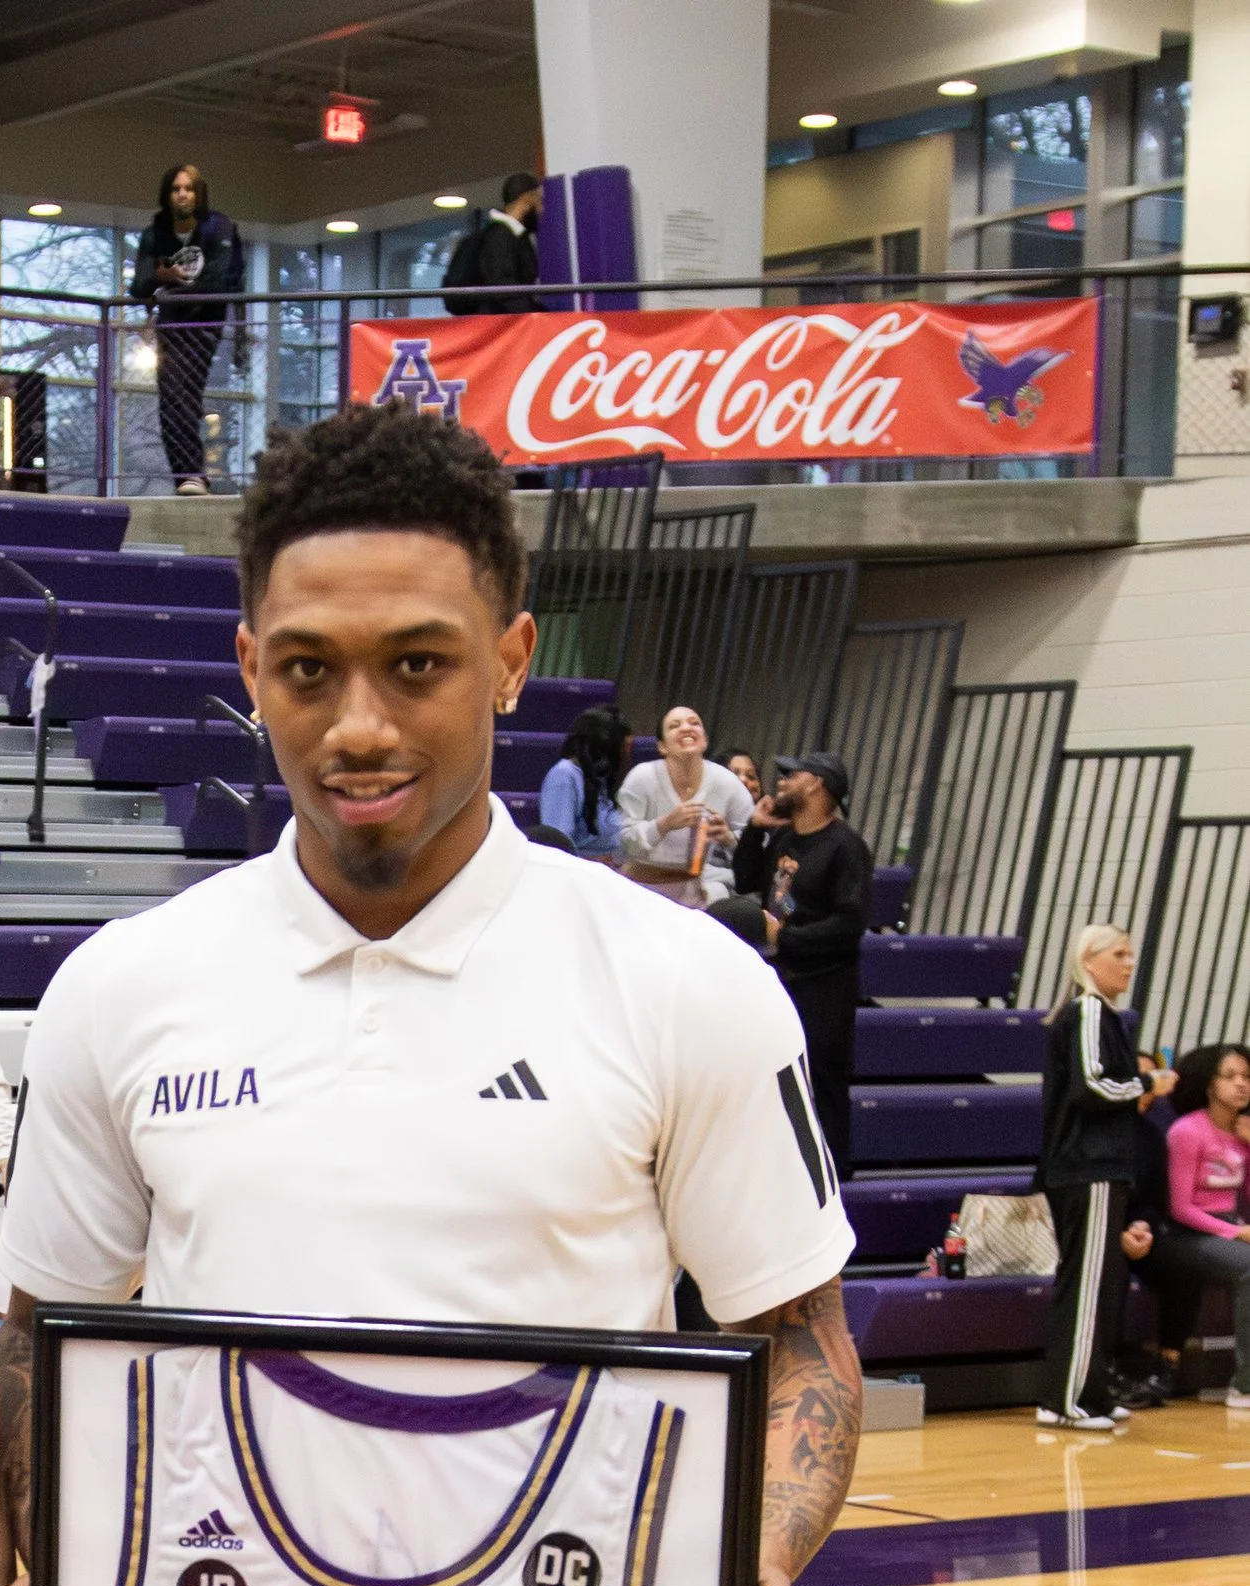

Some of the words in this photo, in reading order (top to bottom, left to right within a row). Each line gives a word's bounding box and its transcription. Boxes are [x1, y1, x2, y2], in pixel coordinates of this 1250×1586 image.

[507, 312, 929, 452] Coca-Cola
[150, 1066, 260, 1116] AVILA
[178, 1534, 245, 1551] adidas
